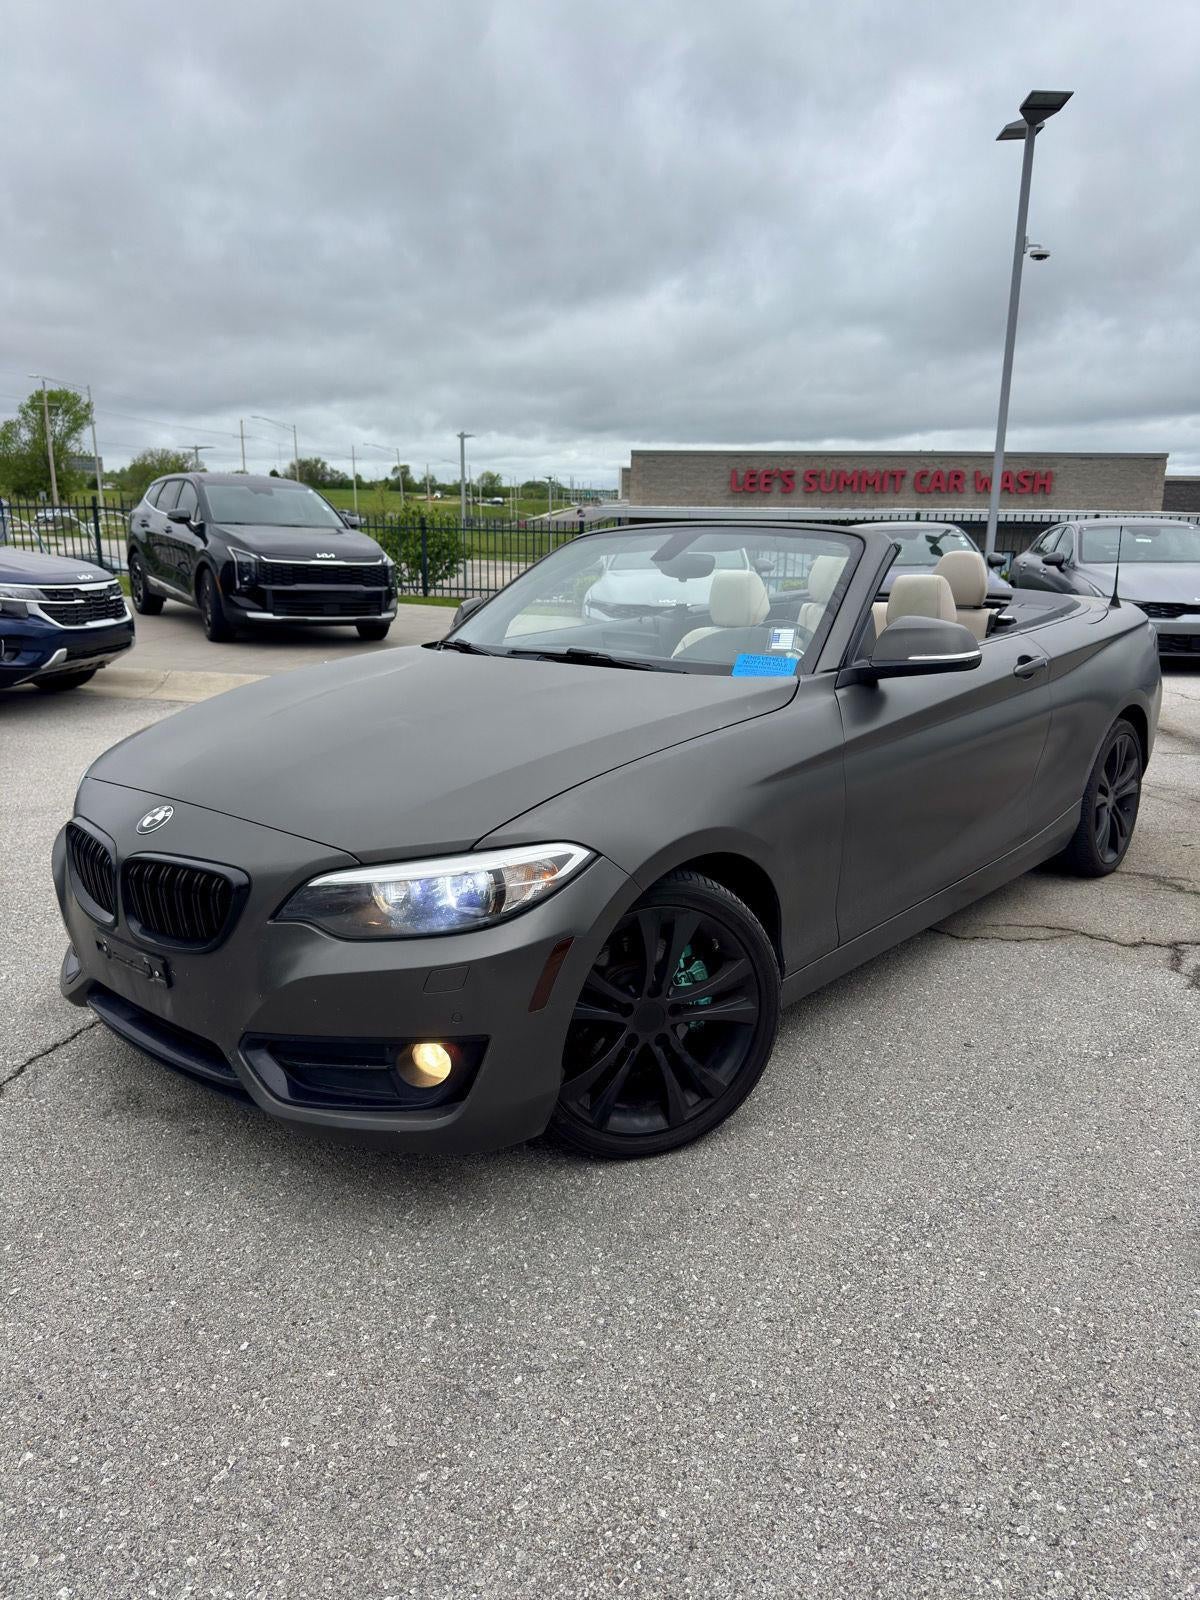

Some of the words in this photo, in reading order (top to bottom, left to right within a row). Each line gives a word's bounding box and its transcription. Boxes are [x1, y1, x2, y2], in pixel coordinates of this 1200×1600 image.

[730, 468, 795, 494] LEE'S
[803, 469, 907, 494] SUMMIT
[914, 469, 966, 495] CAR
[974, 469, 1054, 495] WASH
